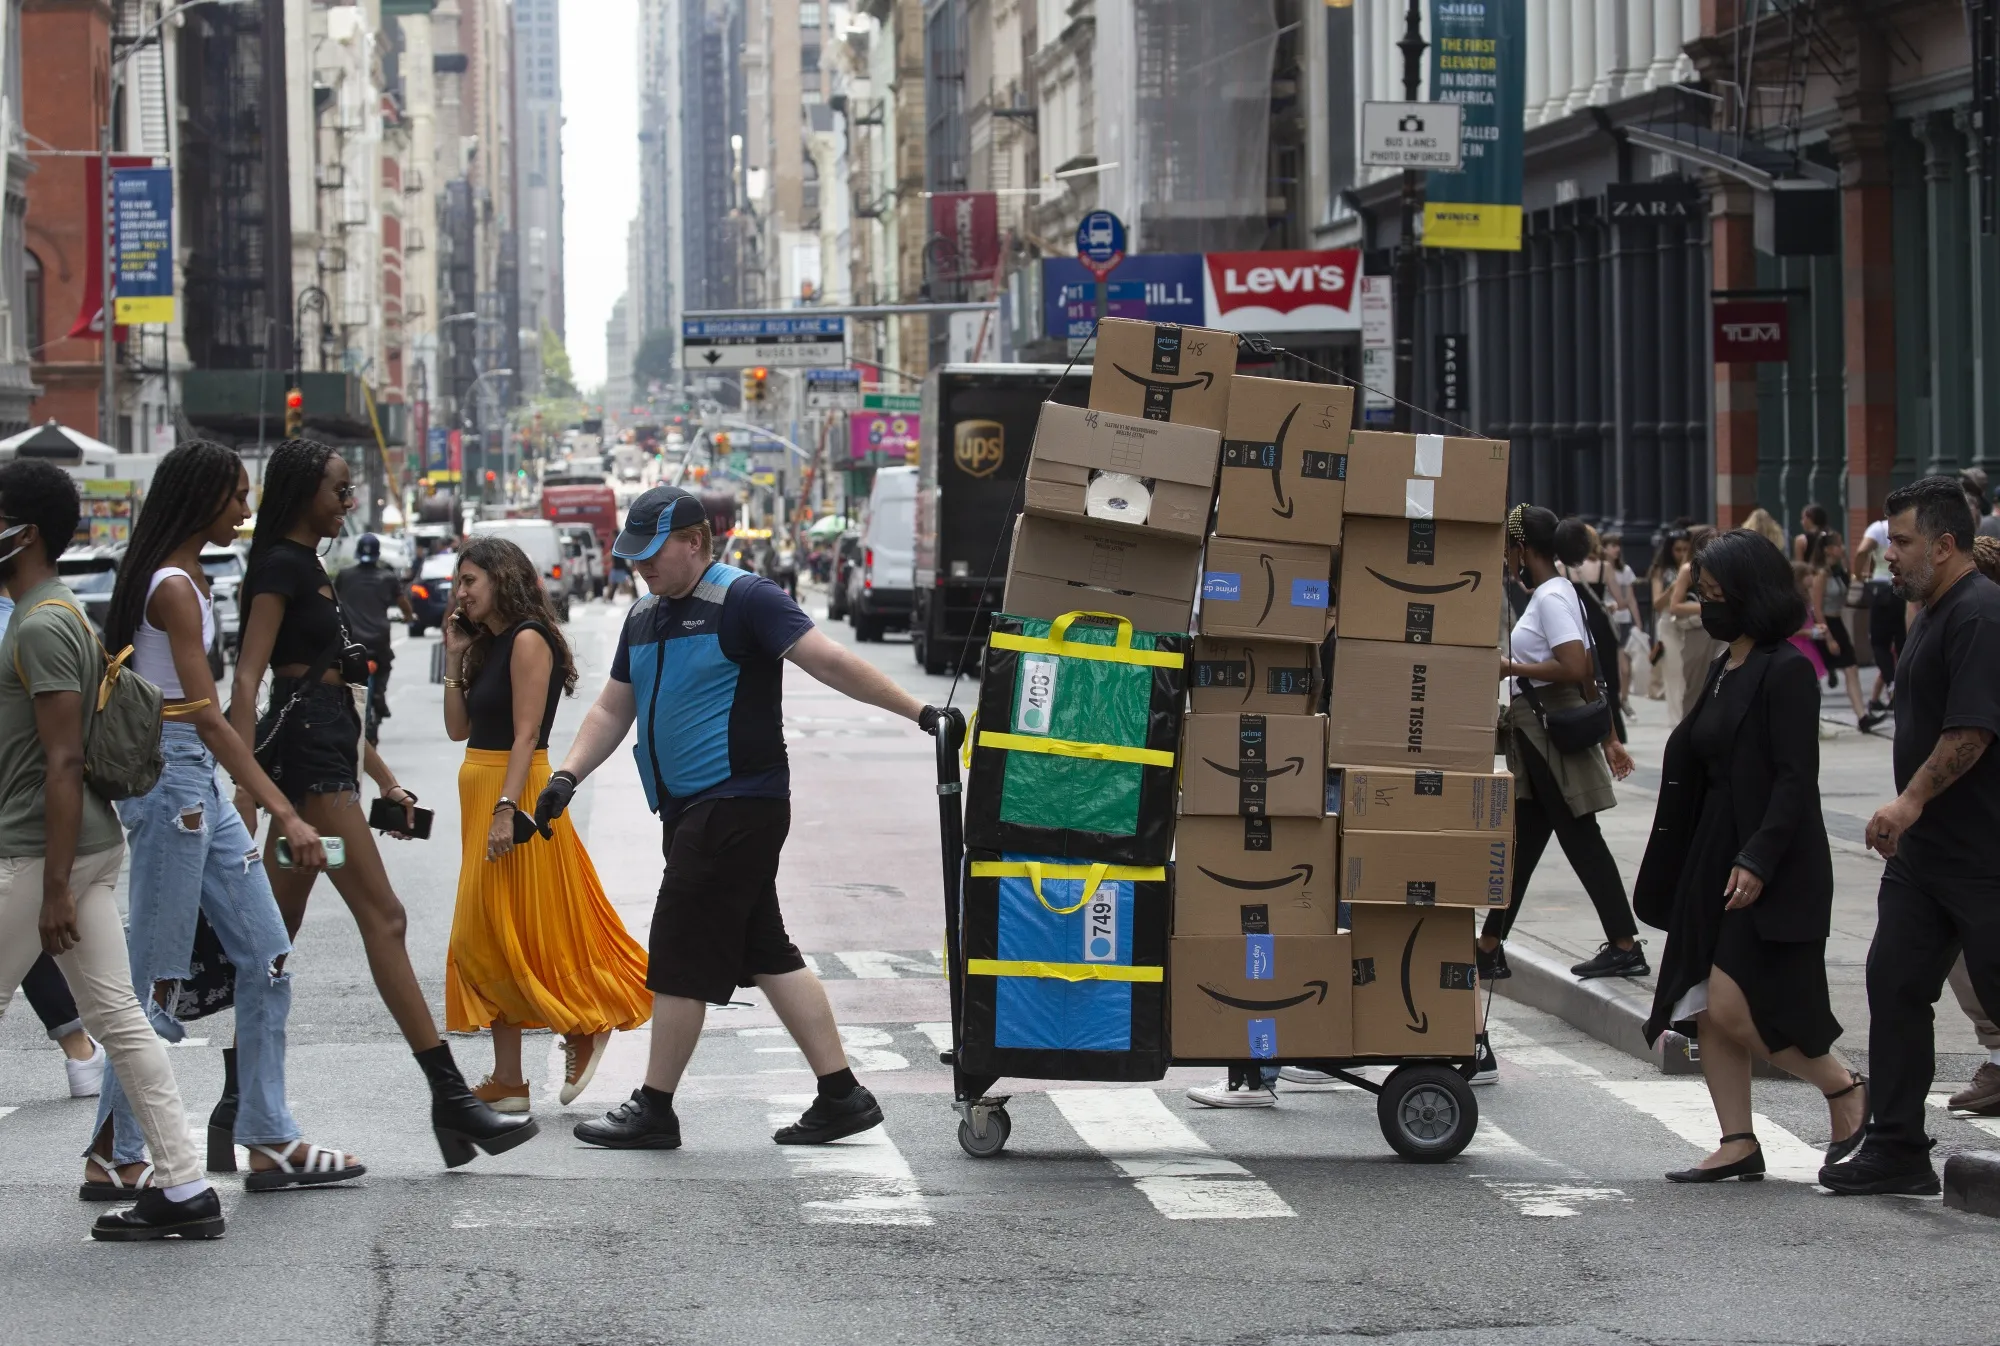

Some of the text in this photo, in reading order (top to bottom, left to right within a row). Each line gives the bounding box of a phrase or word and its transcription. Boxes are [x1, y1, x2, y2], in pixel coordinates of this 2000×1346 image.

[1440, 38, 1496, 53] THE FIRST
[1440, 55, 1497, 69] ELEVATOR
[1440, 73, 1497, 88] IN NORTH
[1440, 91, 1494, 105] AMERICA
[1385, 138, 1437, 148] BUS LANES
[1371, 151, 1450, 162] PHOTO ENFORCED
[1613, 201, 1686, 217] ZARA
[766, 321, 788, 332] BUS
[791, 320, 820, 331] LANE
[1722, 323, 1781, 342] TUMI
[1157, 336, 1178, 346] prime
[1187, 340, 1208, 357] 48
[1445, 338, 1457, 409] PACSUN
[1085, 411, 1099, 429] 48
[958, 437, 1000, 468] ups
[1412, 522, 1434, 530] prime
[1216, 586, 1238, 594] prime
[1305, 585, 1319, 593] July
[682, 619, 705, 628] amazon
[1199, 665, 1207, 686] prime
[1029, 675, 1050, 709] 408
[1408, 665, 1427, 753] BATH TISSUE
[1241, 730, 1262, 738] prime
[1093, 904, 1112, 936] 749
[1254, 944, 1262, 957] day
